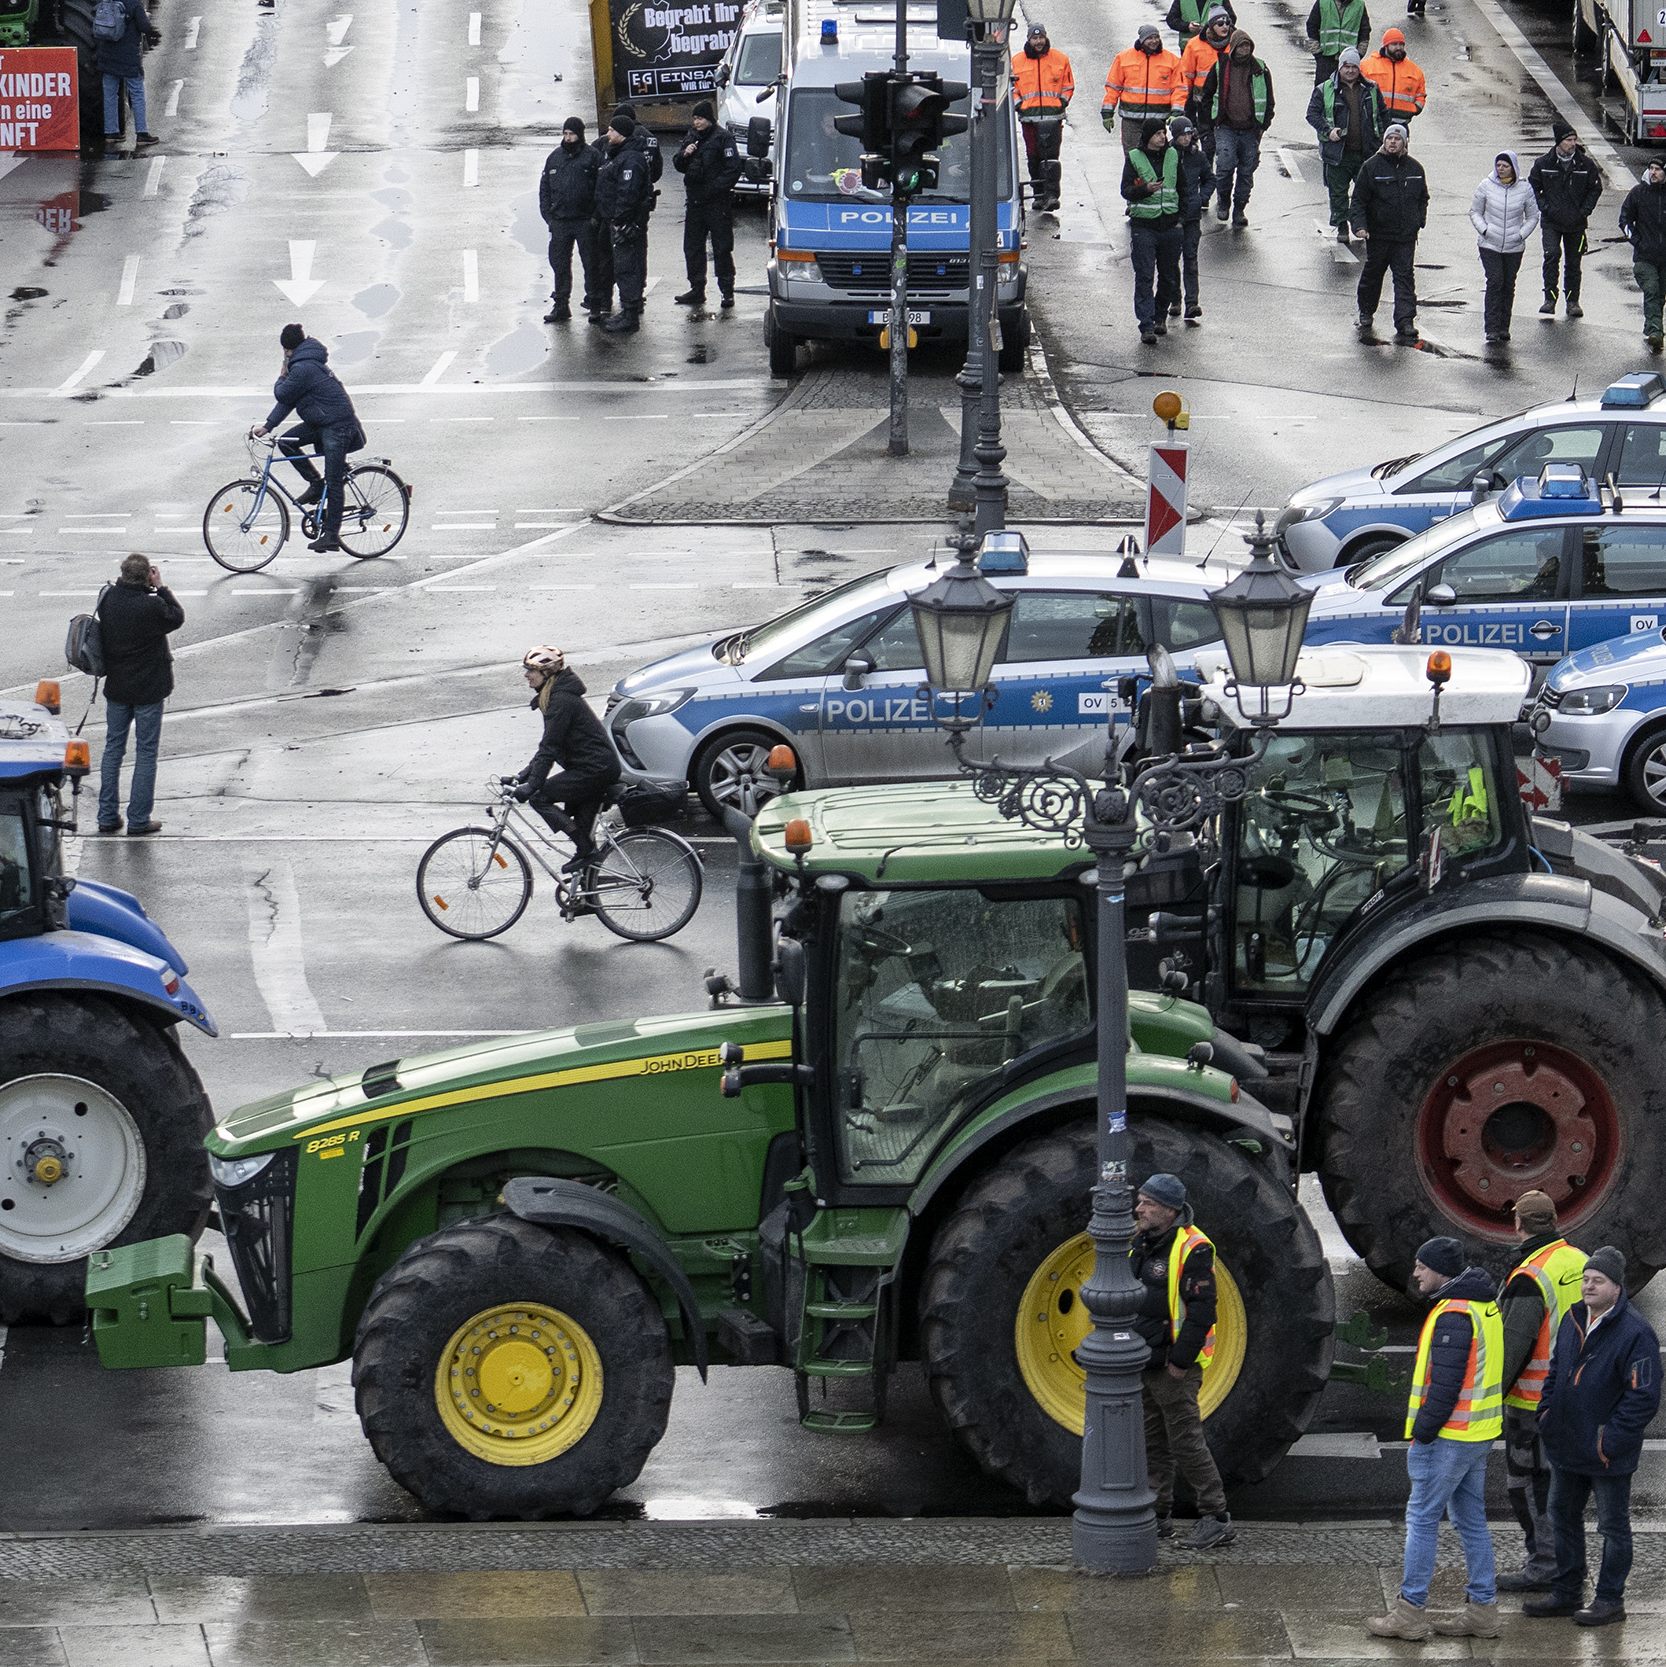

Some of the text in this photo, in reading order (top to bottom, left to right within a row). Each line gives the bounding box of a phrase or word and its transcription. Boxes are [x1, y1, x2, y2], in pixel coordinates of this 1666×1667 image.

[644, 2, 739, 29] Begrabt ihr
[15, 100, 52, 120] eine
[1426, 624, 1523, 645] POLIZEI
[1635, 619, 1653, 630] OV
[827, 698, 933, 722] POLIZE
[1083, 697, 1102, 708] OV
[1361, 889, 1384, 915] PROFI
[641, 1058, 684, 1075] JOHN
[306, 1130, 360, 1154] 8285 R
